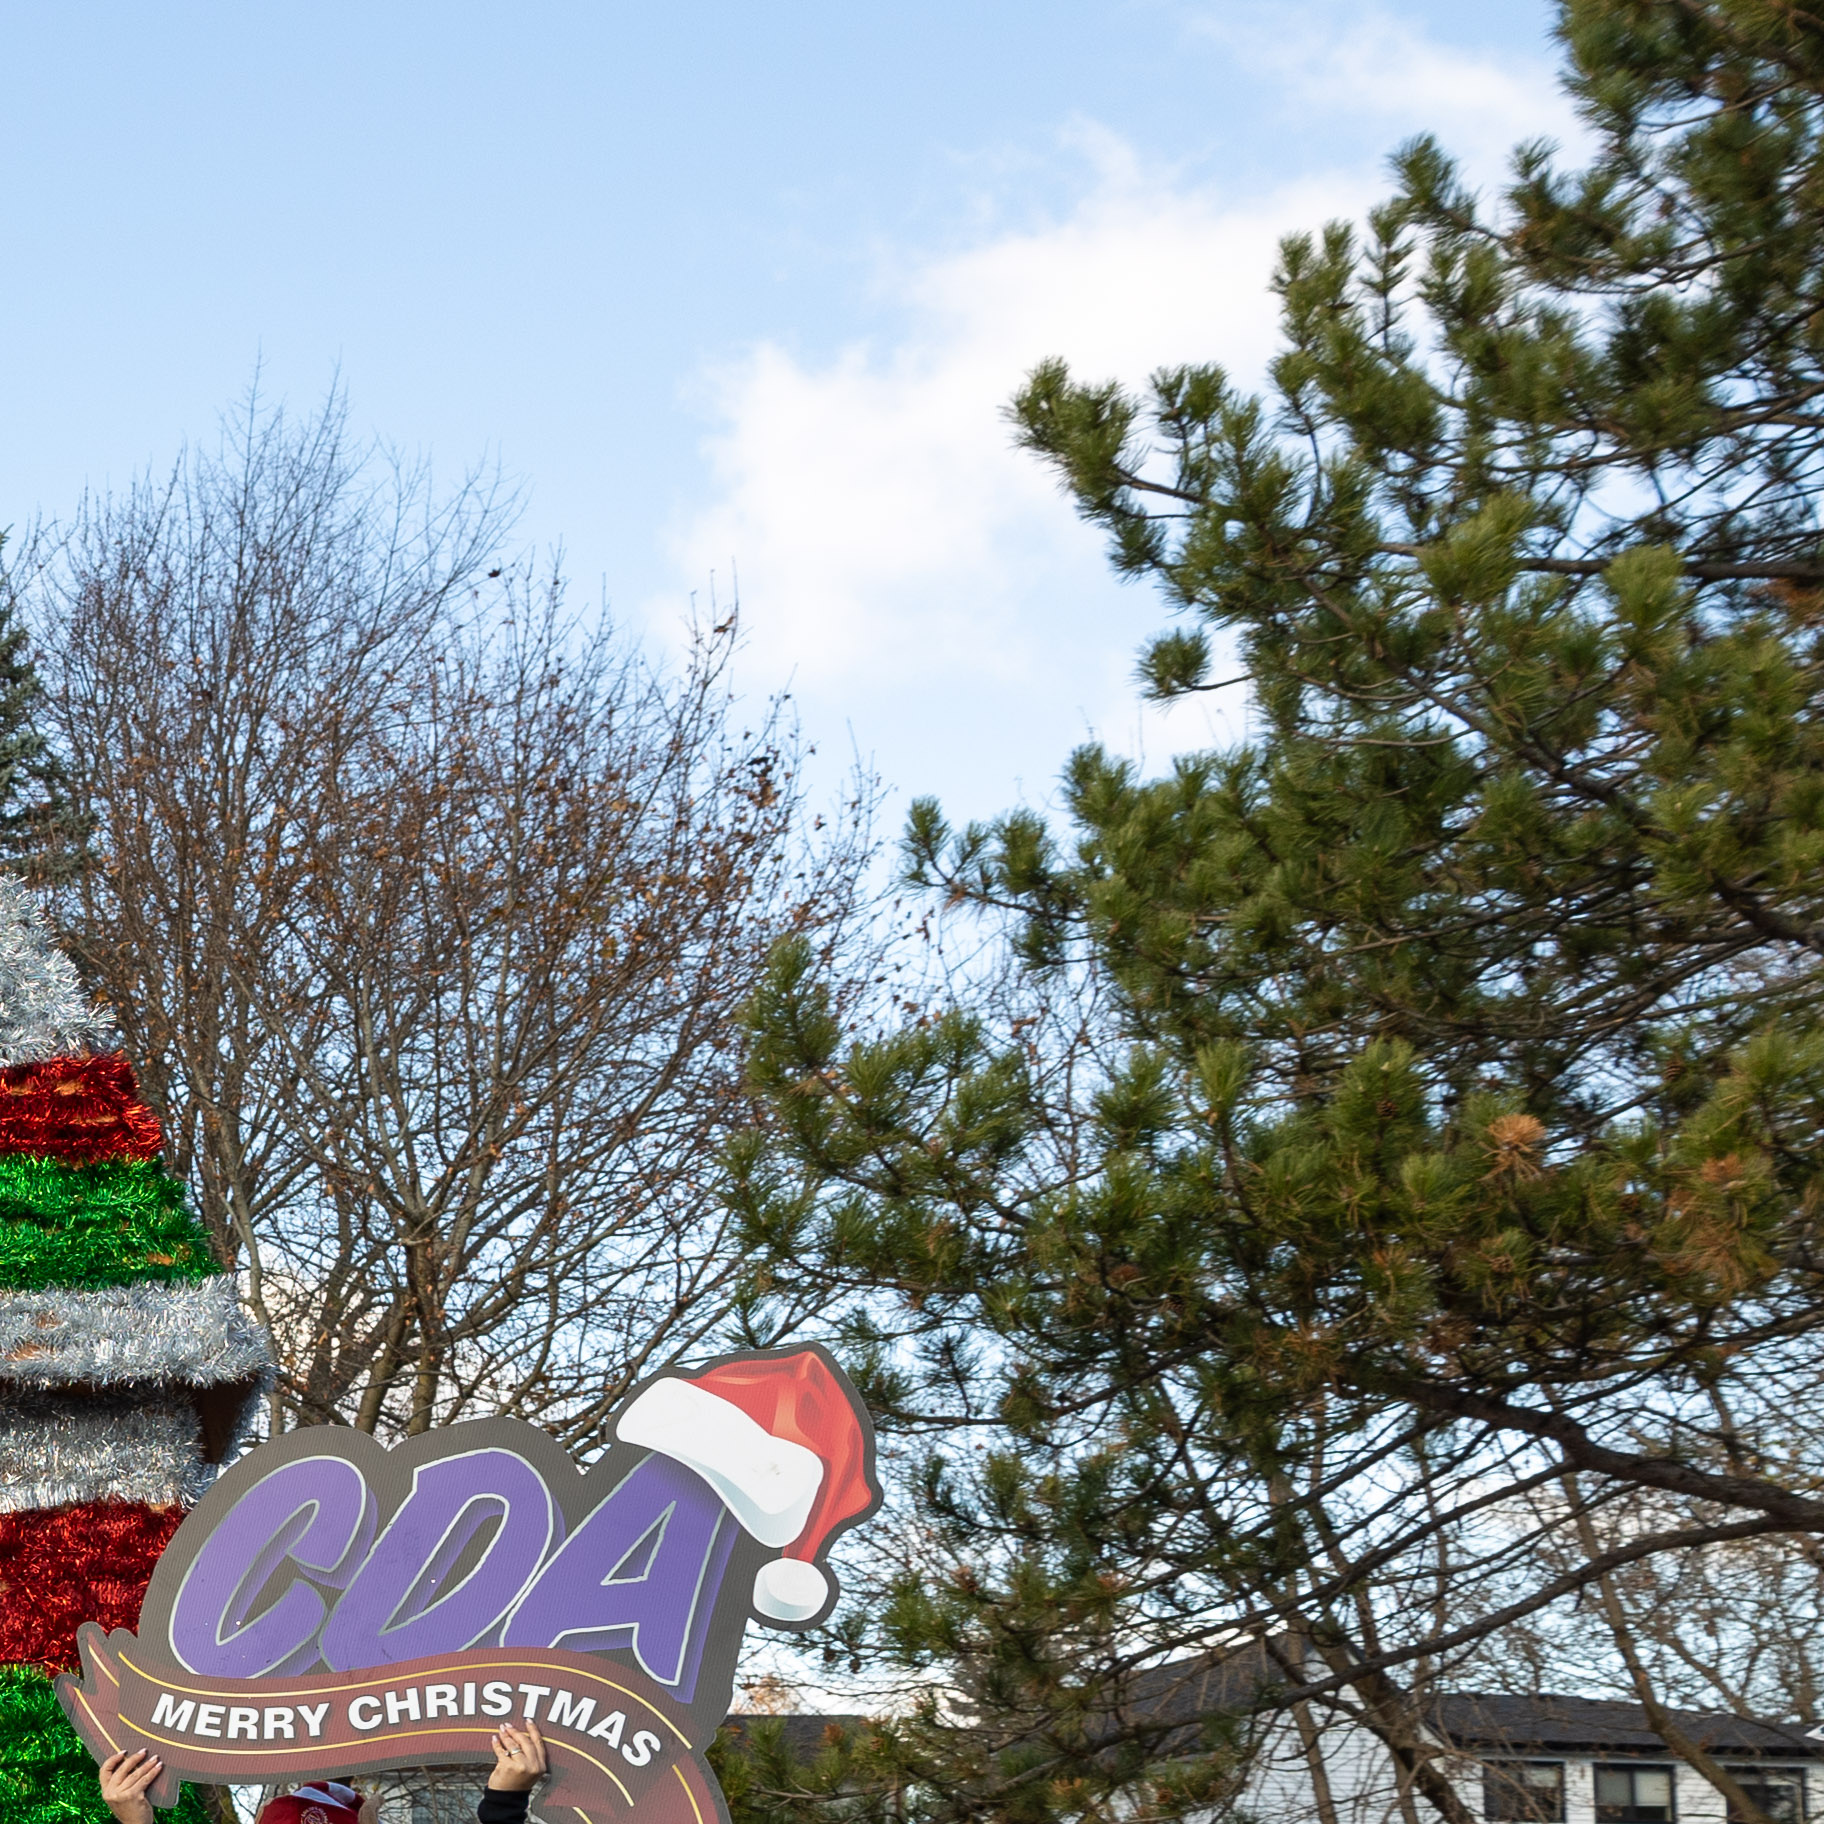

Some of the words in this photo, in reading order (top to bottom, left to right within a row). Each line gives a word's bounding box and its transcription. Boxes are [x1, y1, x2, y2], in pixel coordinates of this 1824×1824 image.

[168, 1446, 740, 1704] CDA
[150, 1692, 331, 1741] MERRY
[346, 1681, 662, 1768] CHRISTMAS
